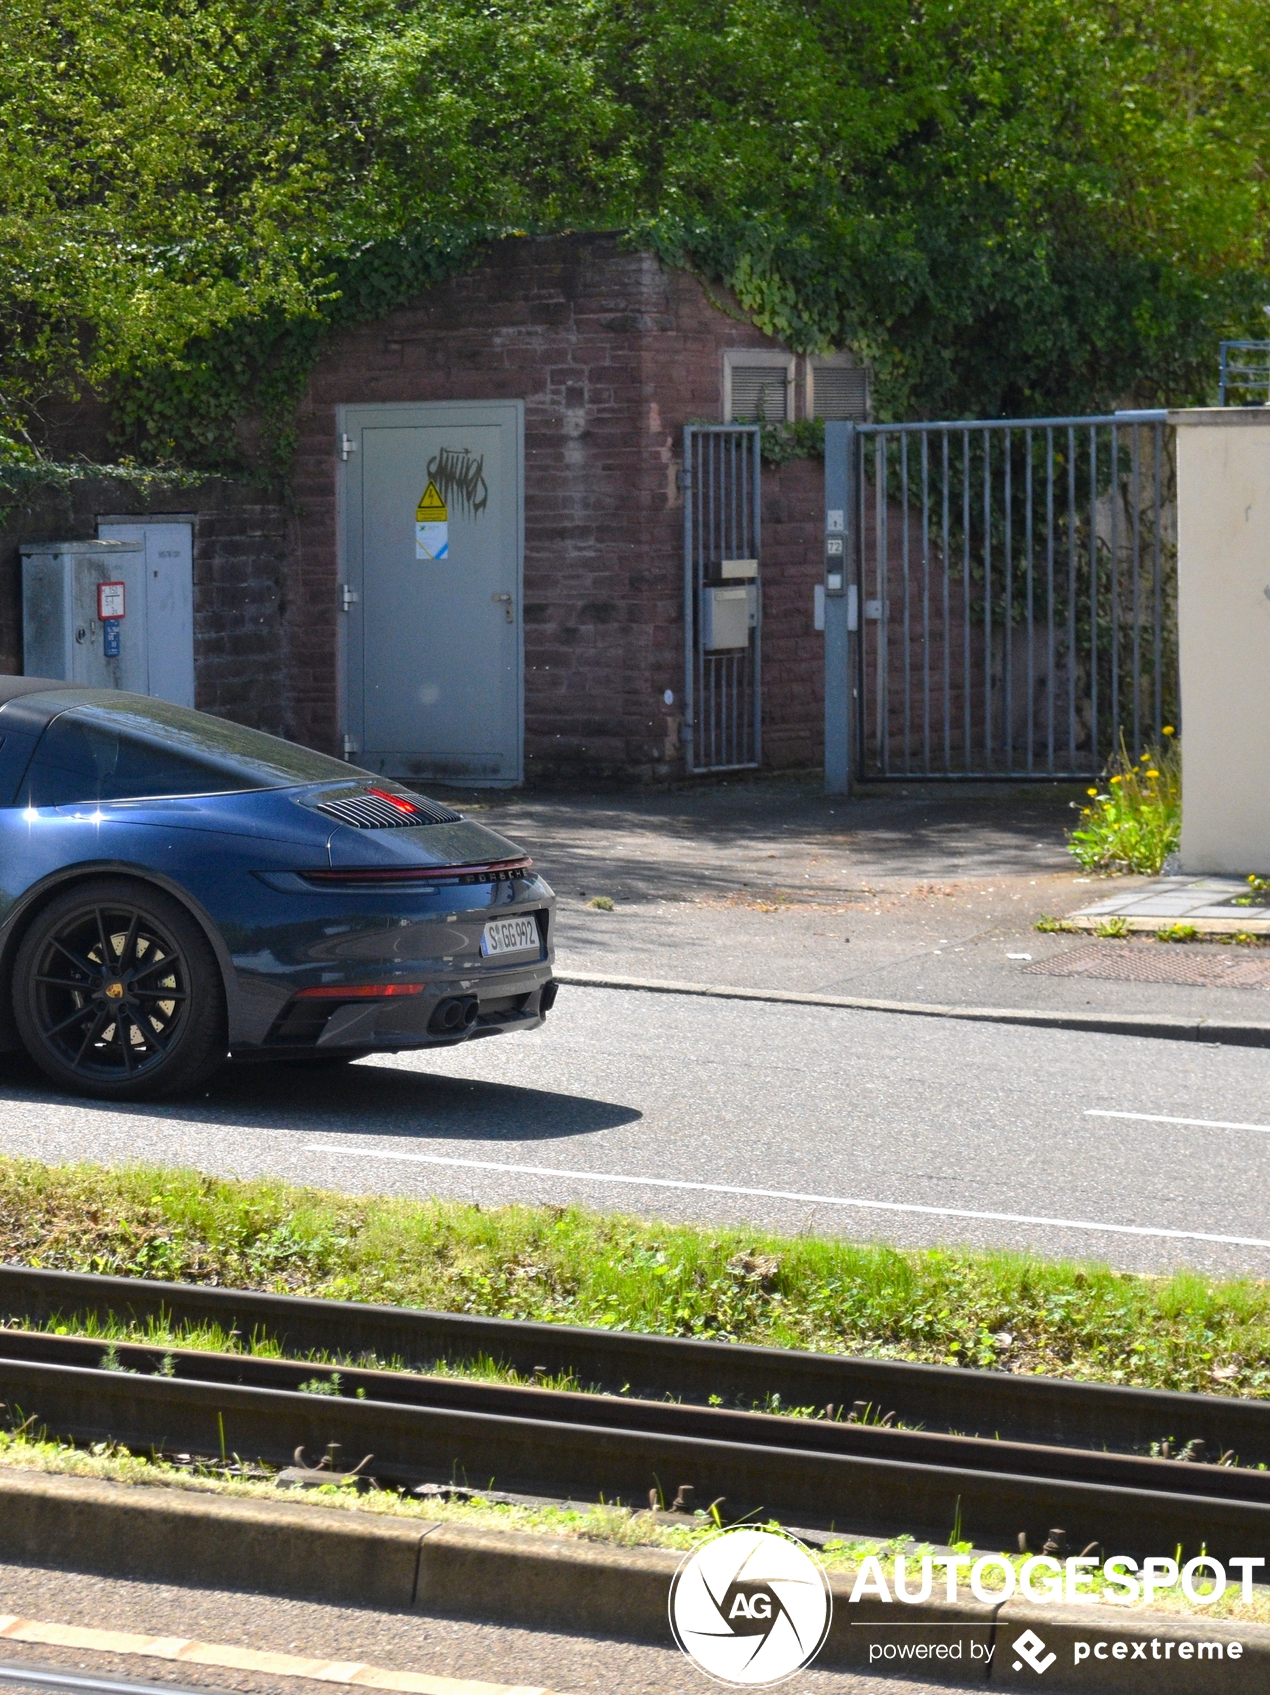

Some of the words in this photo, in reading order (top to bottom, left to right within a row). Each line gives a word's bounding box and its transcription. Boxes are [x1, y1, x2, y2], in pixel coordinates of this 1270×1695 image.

[828, 542, 841, 552] 72
[467, 869, 527, 883] PORSCHE
[489, 926, 498, 951] S
